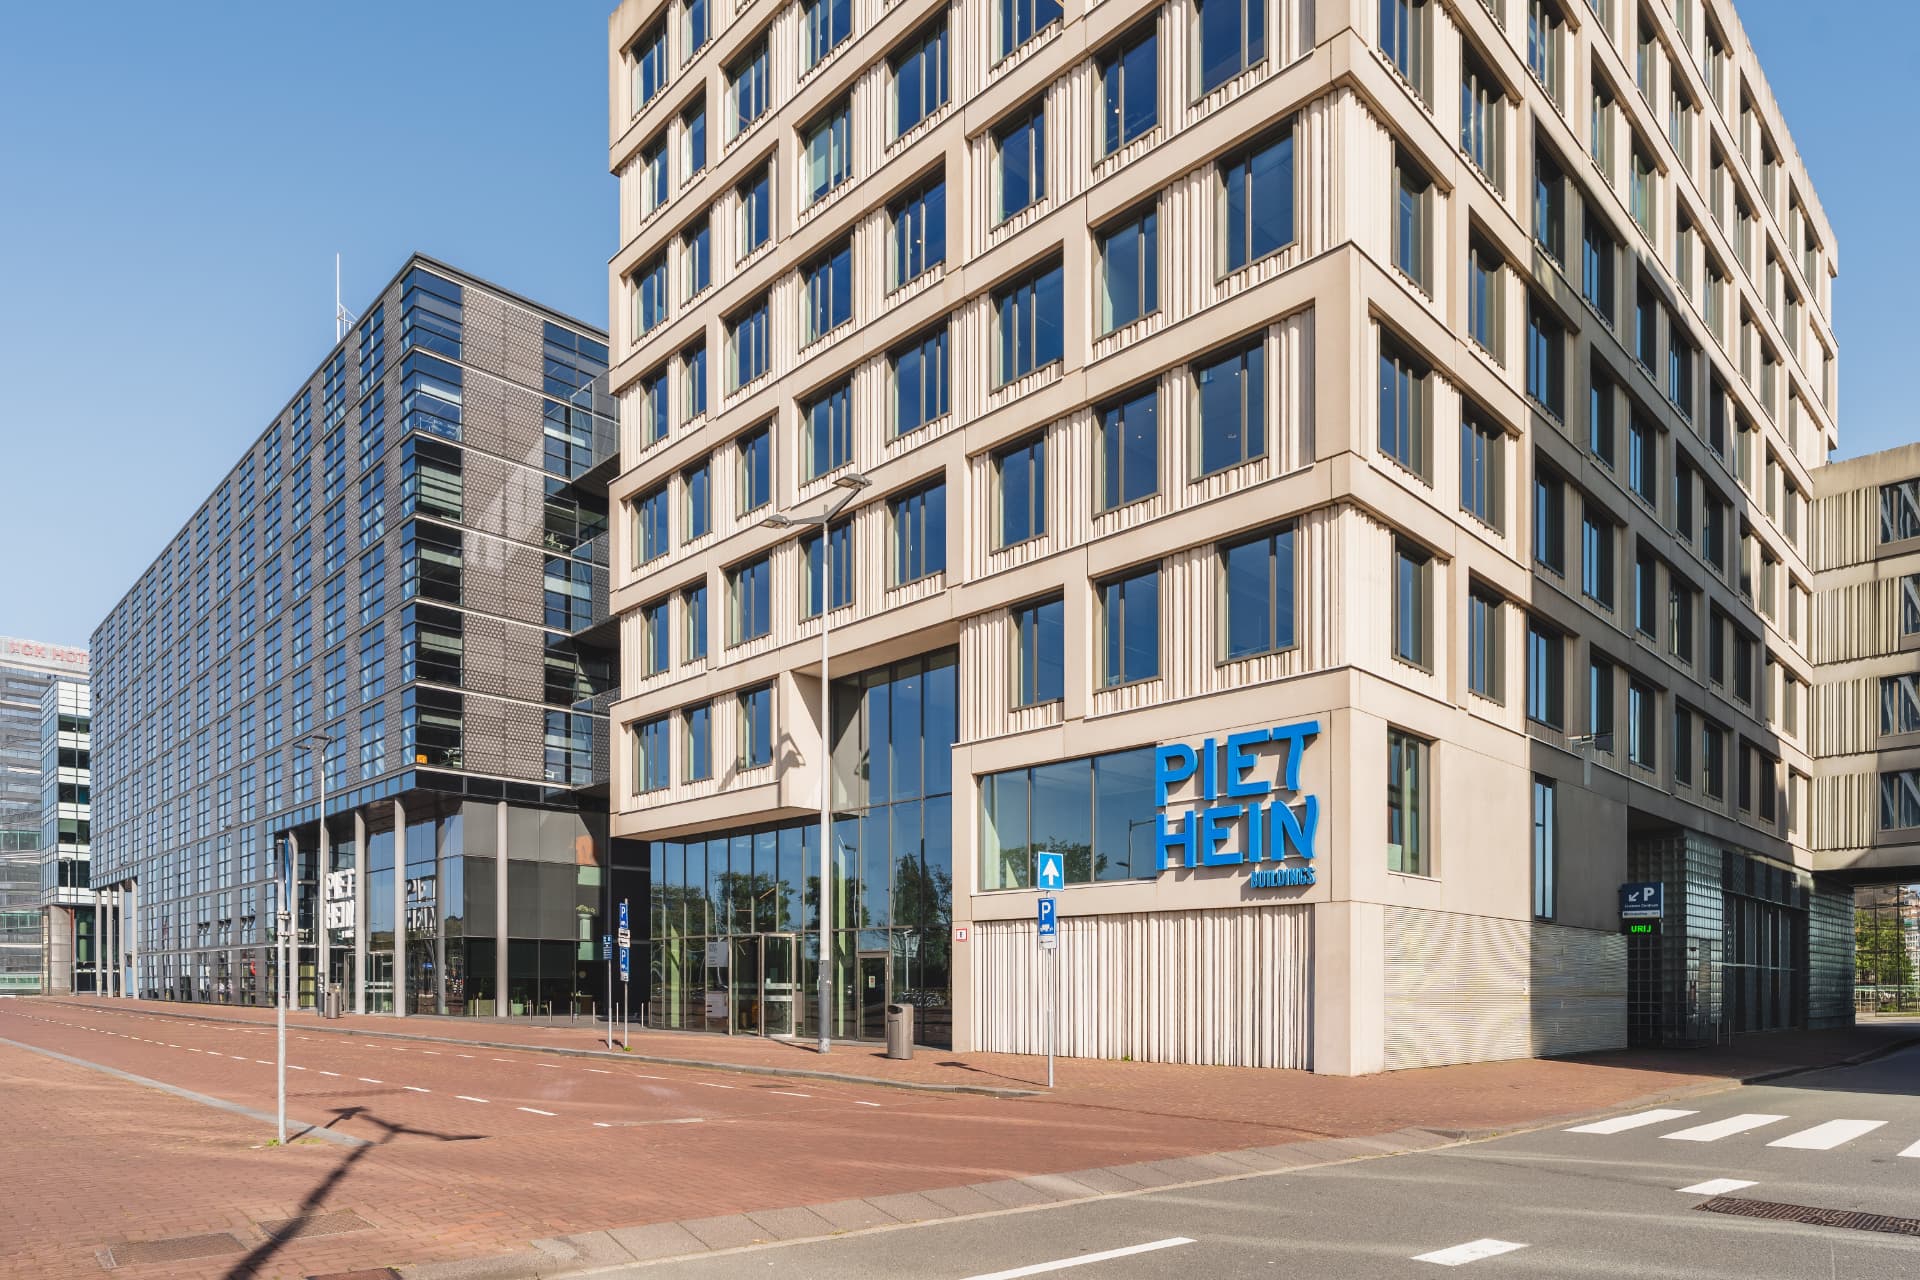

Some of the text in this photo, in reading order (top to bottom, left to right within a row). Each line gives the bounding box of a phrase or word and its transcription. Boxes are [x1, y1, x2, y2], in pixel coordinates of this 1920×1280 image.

[1155, 720, 1322, 807] PIET
[1155, 794, 1321, 871] HEIN
[1250, 867, 1316, 889] BUILDINGS
[1643, 887, 1655, 902] P
[1041, 902, 1051, 921] P
